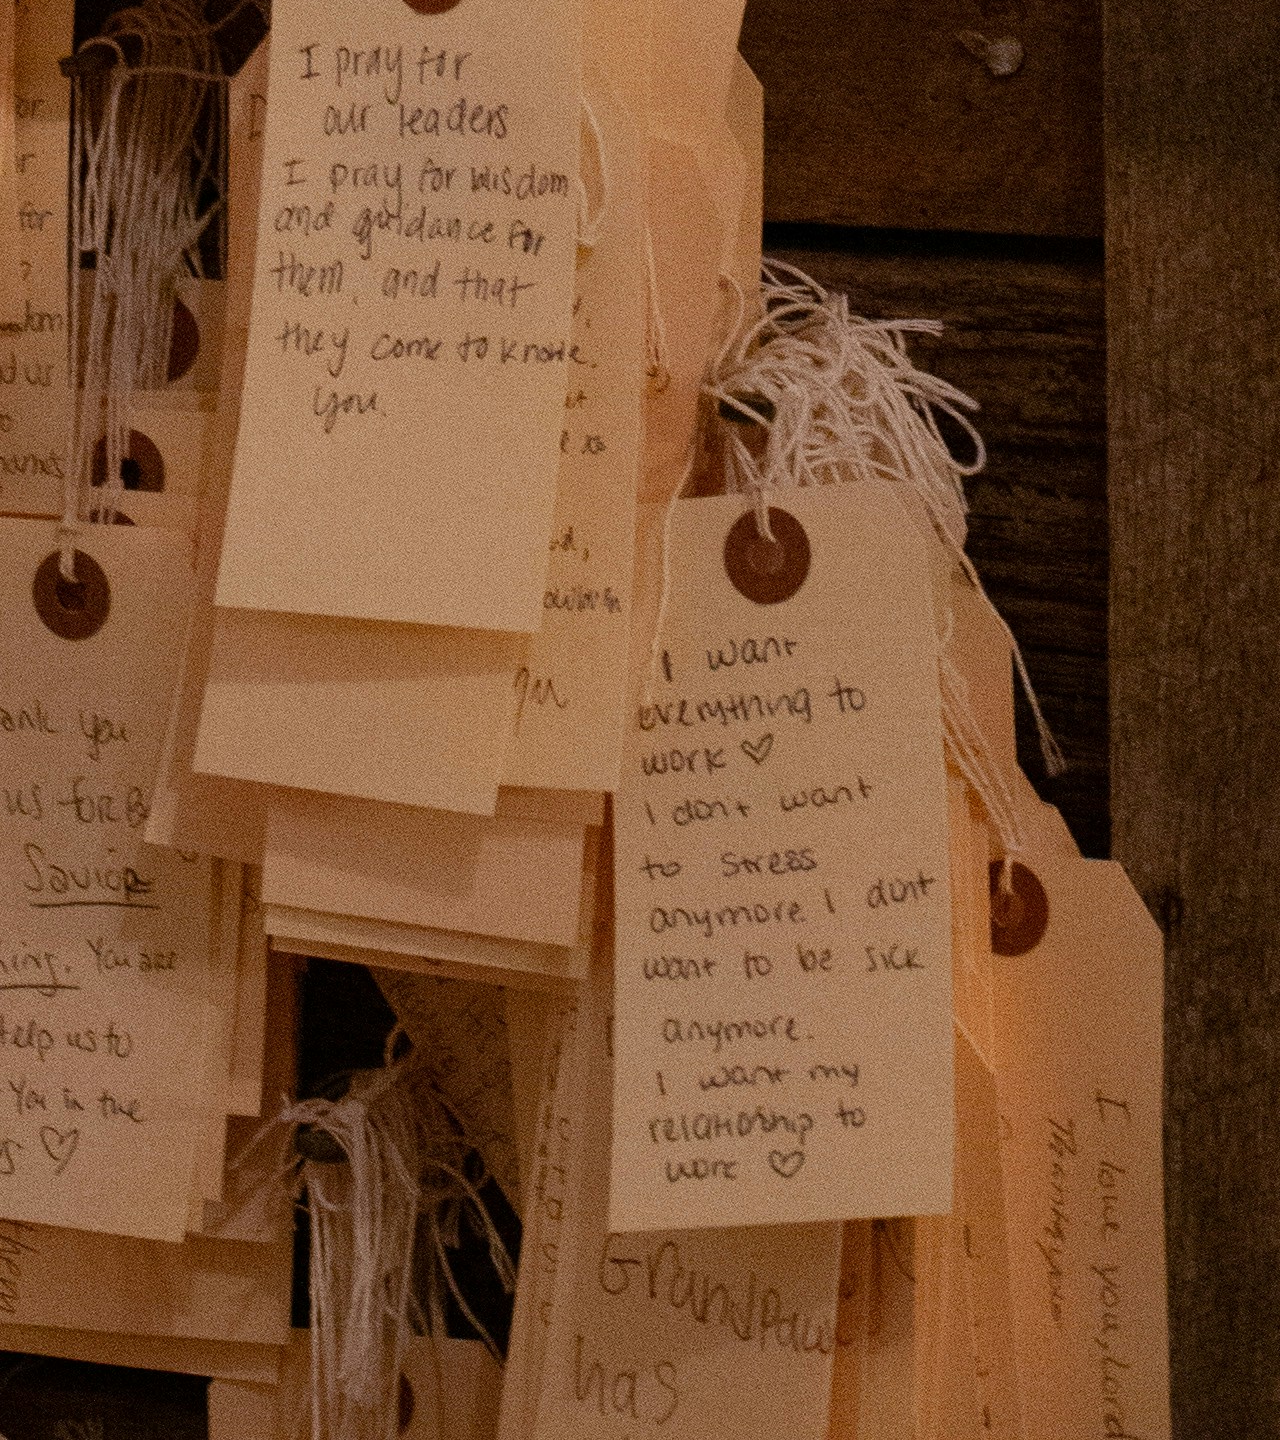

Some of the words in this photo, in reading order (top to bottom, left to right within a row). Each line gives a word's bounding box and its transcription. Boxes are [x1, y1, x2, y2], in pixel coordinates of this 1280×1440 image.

[298, 42, 320, 81] I
[335, 46, 402, 106] pray
[416, 46, 471, 82] for
[323, 104, 371, 136] our
[399, 98, 509, 140] leaders
[382, 262, 440, 298] and
[454, 266, 533, 308] that
[706, 636, 798, 670] want
[636, 686, 813, 732] everything
[828, 679, 866, 714] to
[641, 748, 726, 776] work
[640, 855, 682, 880] to
